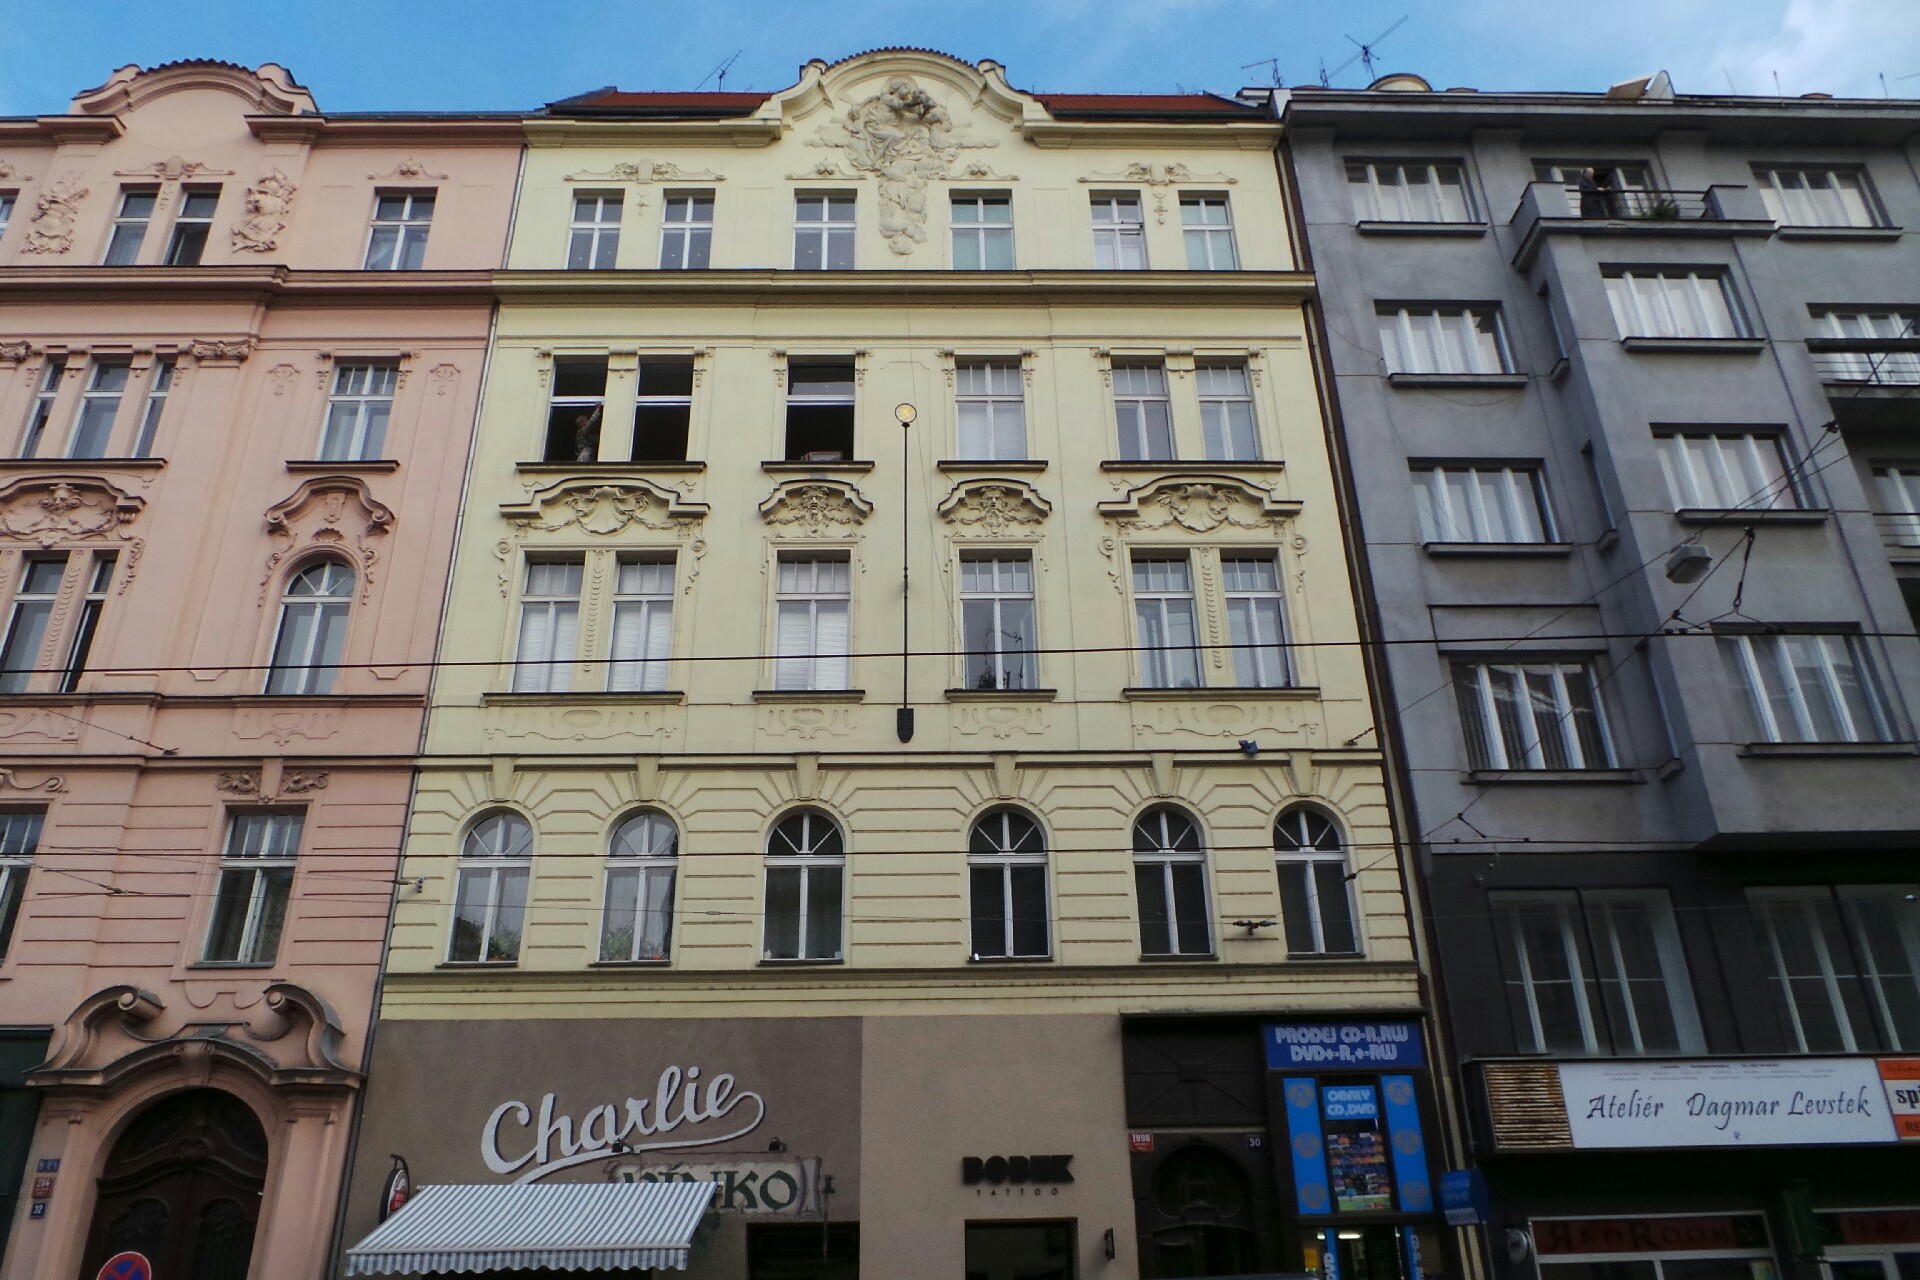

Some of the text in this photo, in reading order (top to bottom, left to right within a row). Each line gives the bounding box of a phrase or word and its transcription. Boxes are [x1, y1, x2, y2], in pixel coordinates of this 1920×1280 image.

[1275, 1026, 1337, 1043] PRODEJ
[1586, 1085, 1872, 1131] Ateliér Dagmar Levstek
[481, 1065, 765, 1186] Charlie
[1248, 1138, 1261, 1148] 30
[976, 1187, 1059, 1196] TATTOO
[33, 1204, 43, 1214] 32
